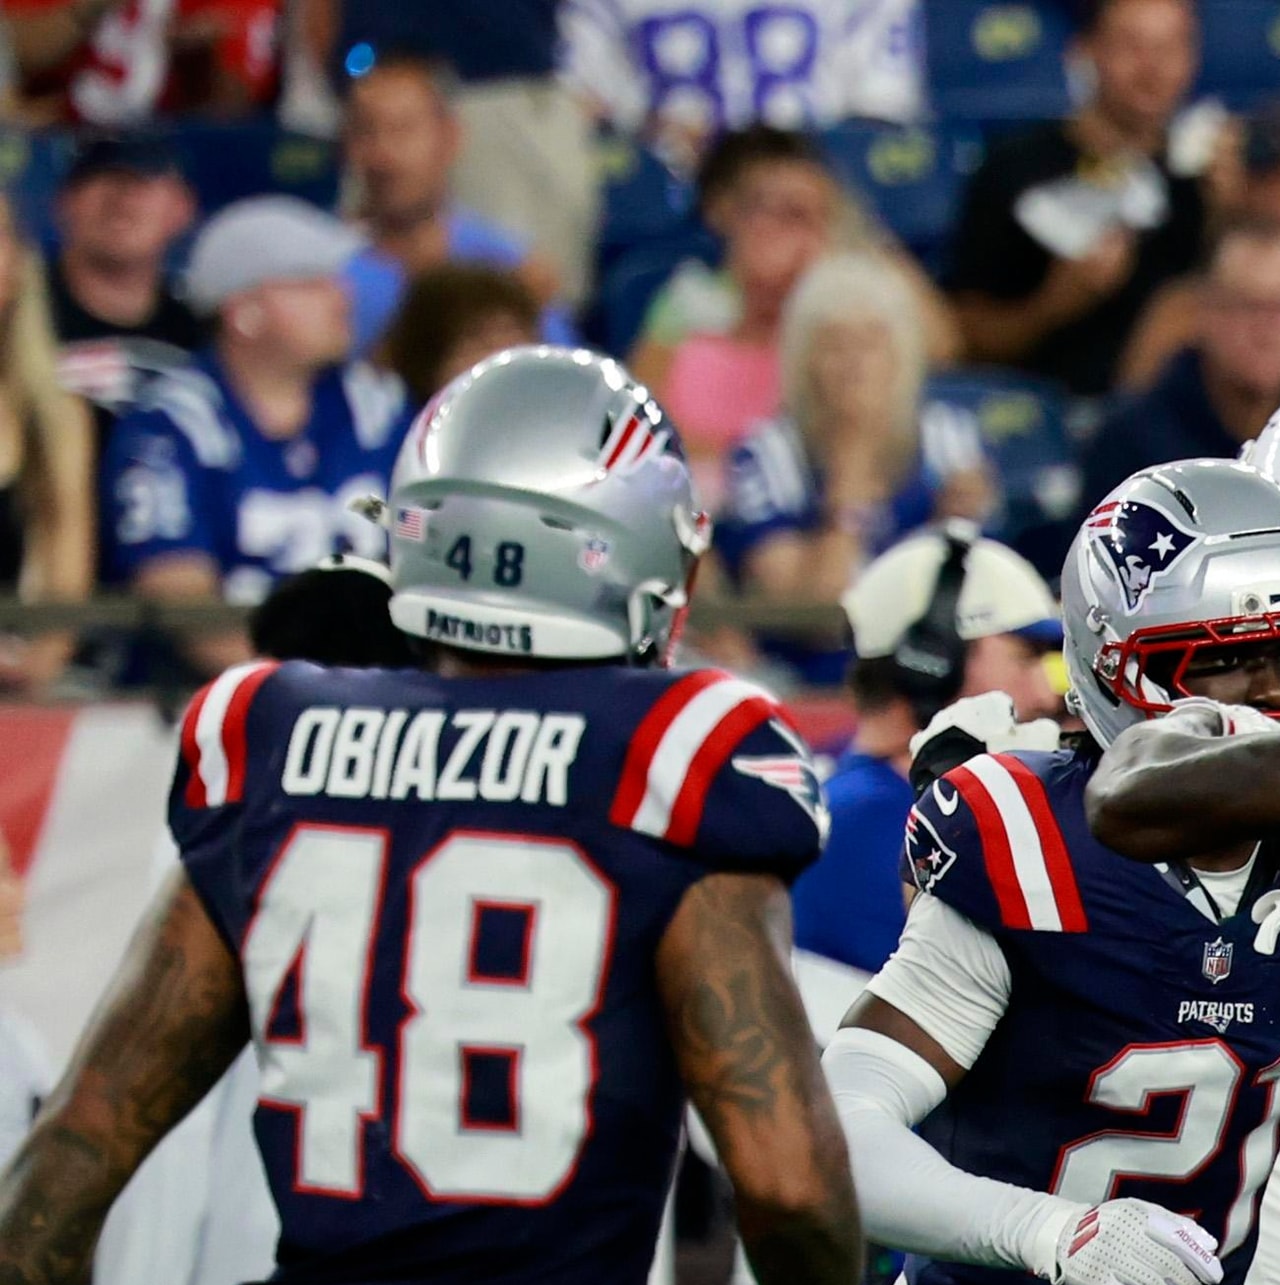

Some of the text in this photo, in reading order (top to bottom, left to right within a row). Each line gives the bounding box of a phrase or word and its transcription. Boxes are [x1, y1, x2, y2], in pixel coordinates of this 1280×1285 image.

[445, 534, 526, 588] 48
[425, 609, 534, 653] PATRIOTS
[281, 707, 586, 807] OBIAZOR
[240, 820, 620, 1208] 48
[1177, 1000, 1255, 1024] PATRIOTS
